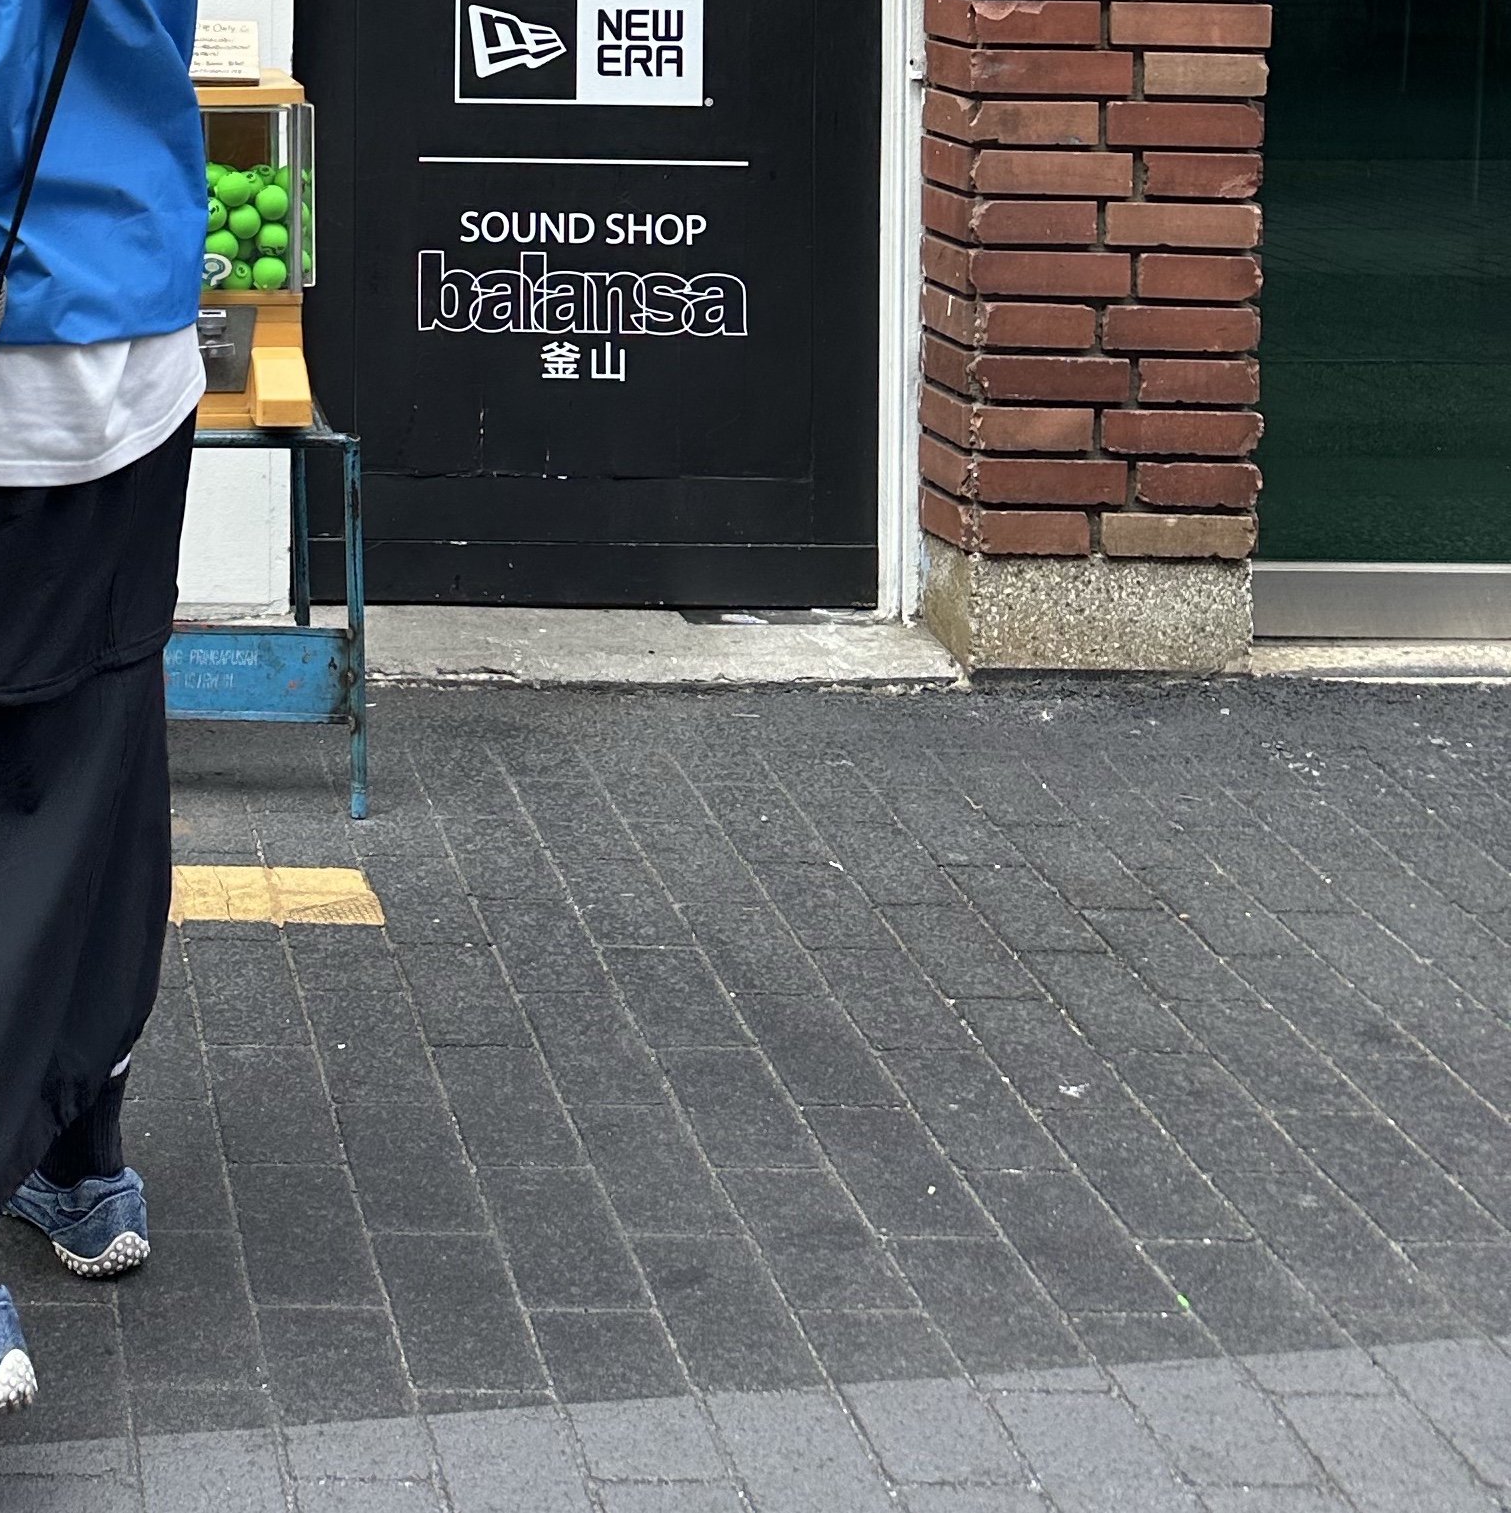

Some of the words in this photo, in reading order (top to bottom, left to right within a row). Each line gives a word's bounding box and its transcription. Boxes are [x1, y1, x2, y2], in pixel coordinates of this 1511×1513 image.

[597, 8, 683, 42] NEW
[597, 45, 683, 77] ERA
[460, 211, 595, 244] SOUND
[605, 213, 707, 246] SHOP
[418, 250, 748, 336] balansa
[541, 341, 626, 382] 釜山
